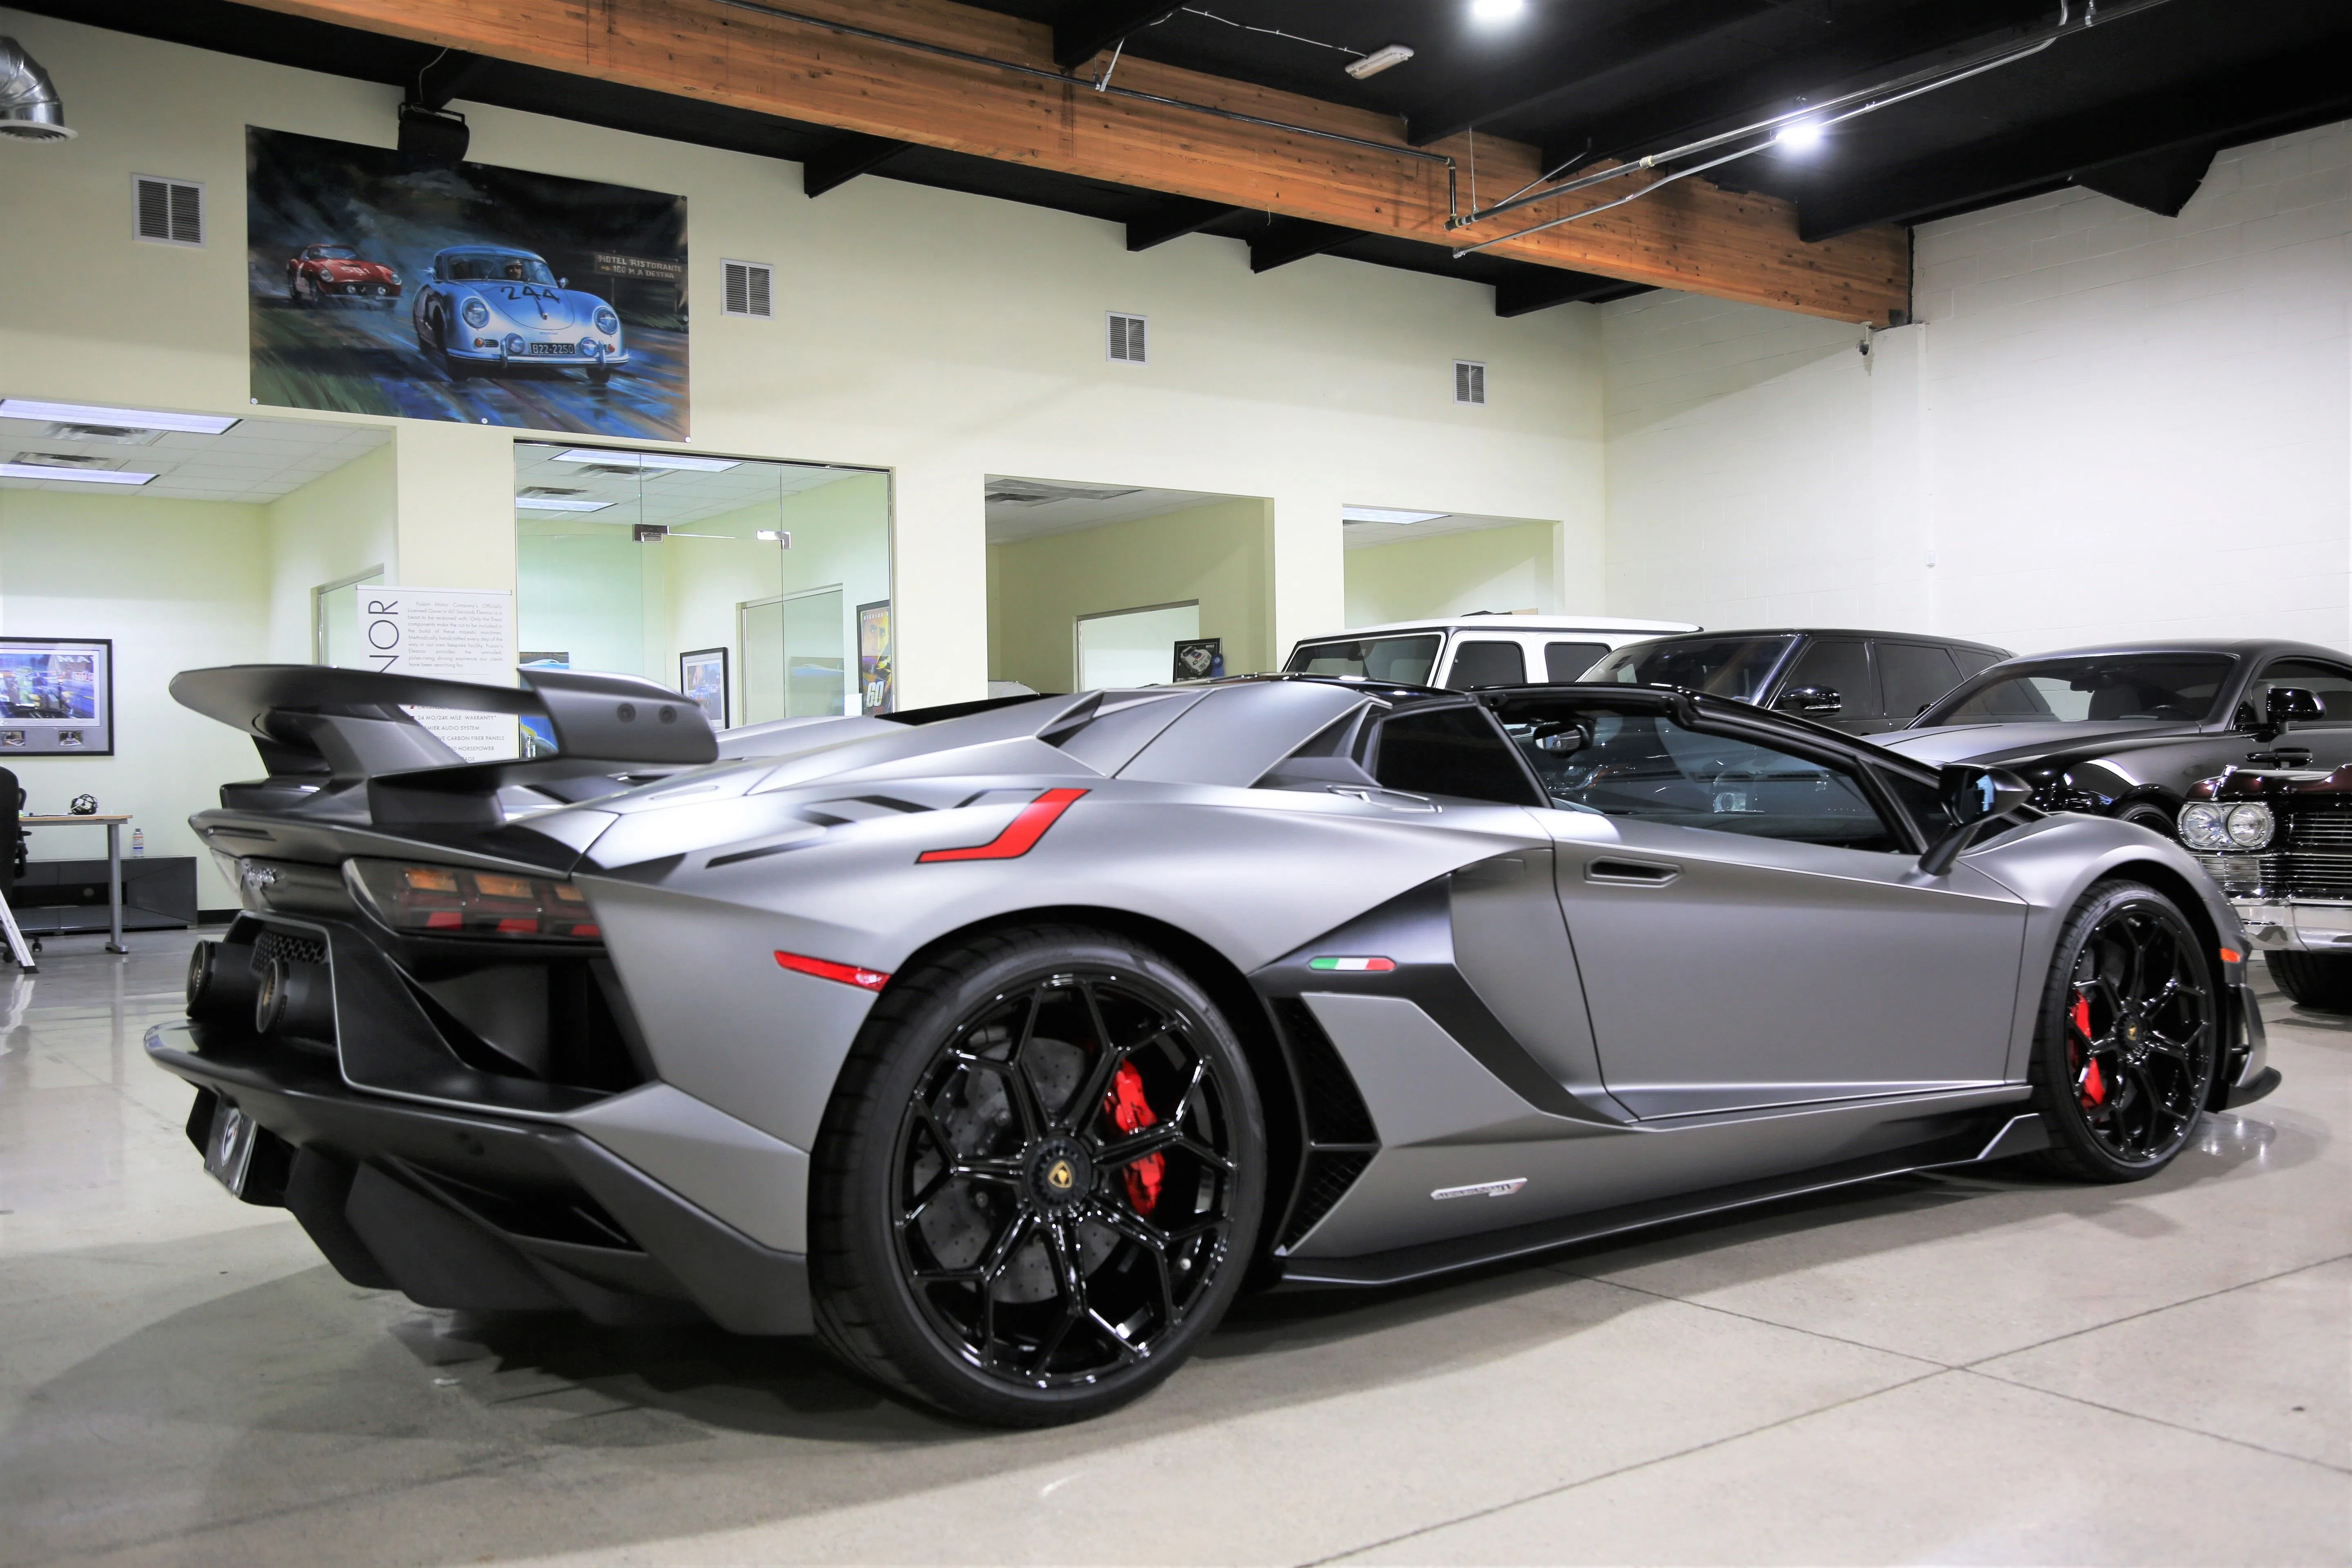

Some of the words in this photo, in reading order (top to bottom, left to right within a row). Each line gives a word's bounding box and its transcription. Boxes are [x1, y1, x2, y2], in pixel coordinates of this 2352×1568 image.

[597, 255, 627, 265] HOTEL
[630, 259, 683, 272] RISTORANTE
[645, 270, 674, 279] DESTRA
[500, 286, 561, 304] 244
[866, 681, 884, 708] 60
